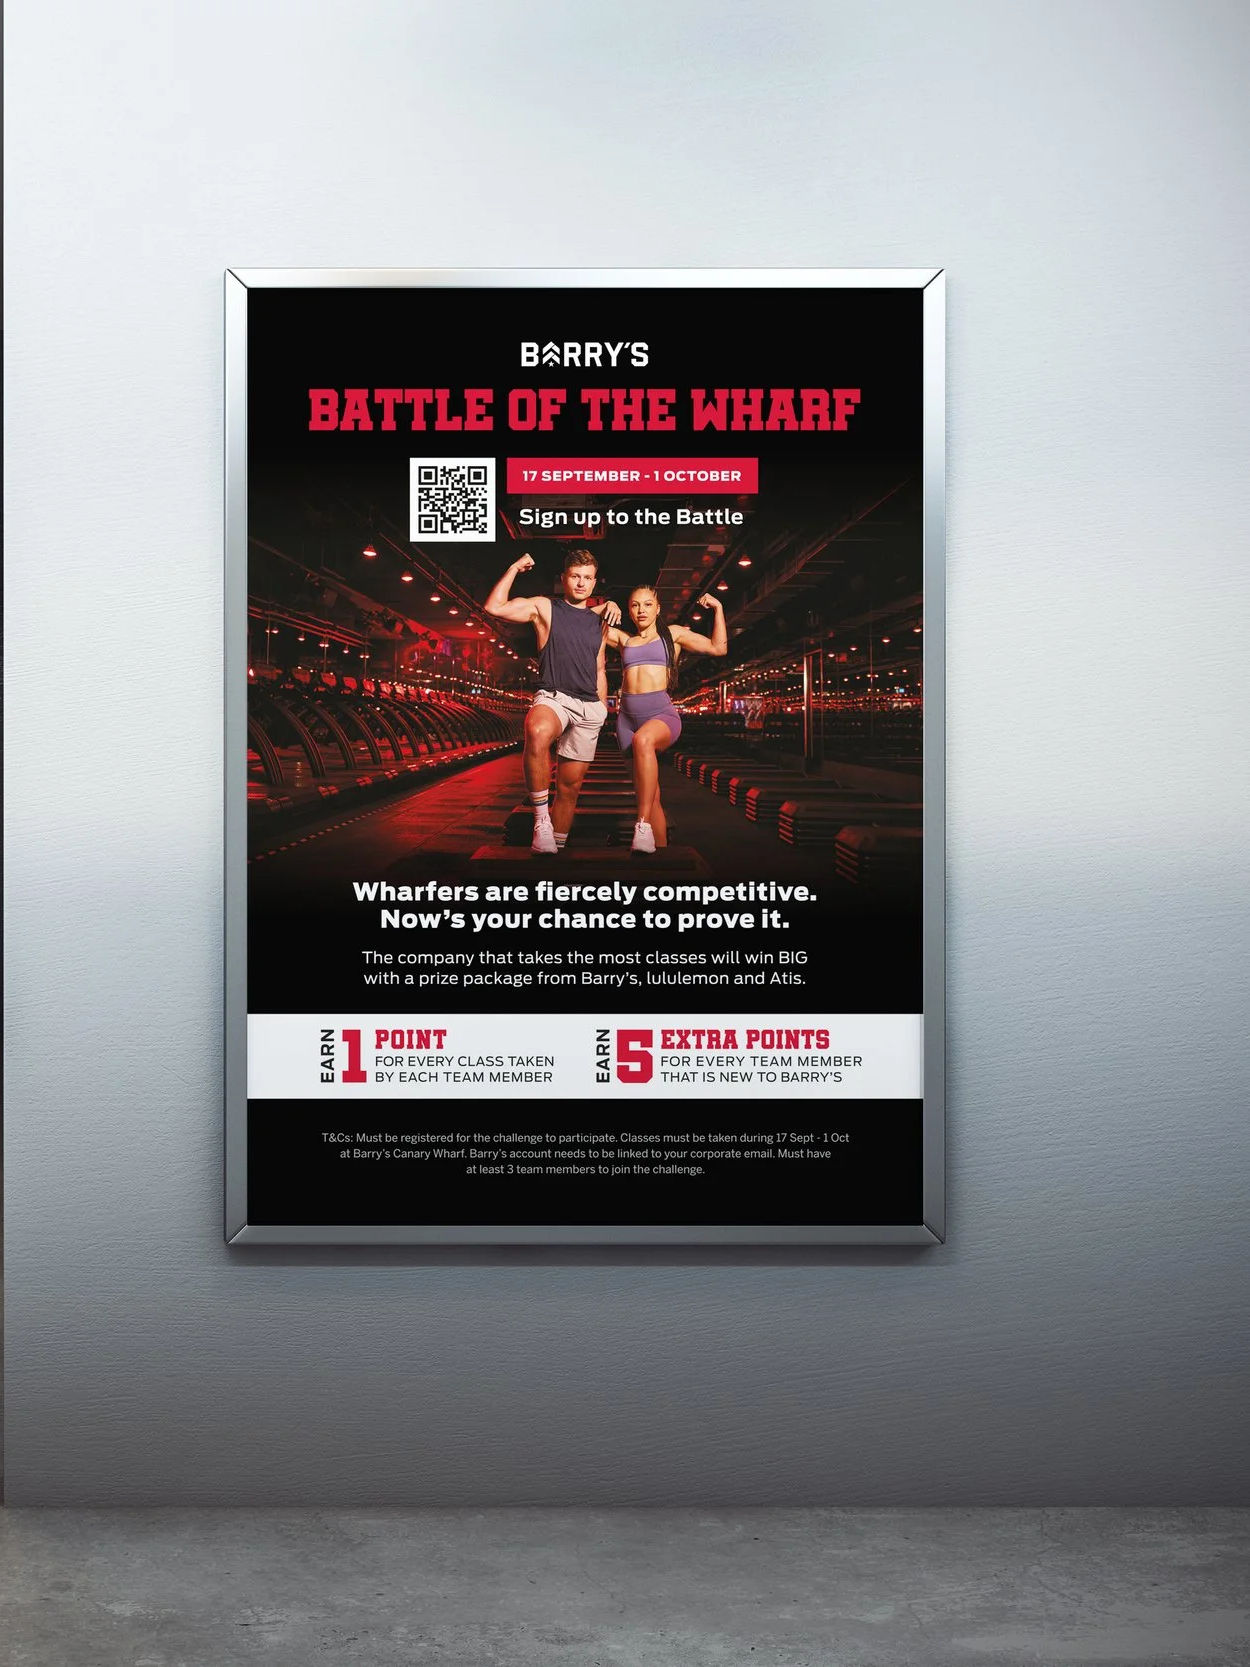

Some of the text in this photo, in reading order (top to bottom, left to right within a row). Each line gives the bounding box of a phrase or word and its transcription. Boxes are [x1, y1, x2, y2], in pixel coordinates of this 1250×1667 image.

[308, 388, 861, 431] BATTLE OF THE WHARF
[522, 470, 538, 482] 17
[541, 470, 641, 482] SEPTEMBER
[663, 470, 742, 482] OCTOBER
[519, 507, 744, 529] Sign up to the Battle
[352, 880, 817, 906] Wharfers are fiercely competitive.
[380, 908, 790, 933] Now's your chance to prove it.
[361, 950, 808, 967] The company that takes the most classes will win BIG
[363, 971, 806, 988] with a prize package from Barry's, lululemon and Atis.
[375, 1029, 447, 1050] POINT
[660, 1029, 830, 1050] EXTRA POINTS
[320, 1029, 335, 1083] EARN
[341, 1029, 367, 1084] 1
[375, 1055, 555, 1067] FOR EVERY CLASS TAKEN
[595, 1029, 611, 1084] EARN
[616, 1029, 654, 1084] 5
[660, 1055, 863, 1067] FOR EVERY TEAM MEMBER
[375, 1071, 553, 1083] BY EACH TEAM MEMBER
[660, 1071, 843, 1083] THAT IS NEW TO BARRY'S
[321, 1132, 354, 1143] T&Cs:
[356, 1132, 383, 1143] Must
[384, 1132, 399, 1143] be
[400, 1132, 454, 1145] registered
[455, 1132, 472, 1143] for
[472, 1132, 491, 1143] the
[492, 1132, 544, 1145] challenge
[544, 1132, 557, 1143] to
[558, 1132, 618, 1145] participate.
[620, 1132, 661, 1143] Classes
[663, 1132, 691, 1143] must
[692, 1132, 706, 1143] be
[707, 1132, 738, 1143] taken
[739, 1132, 774, 1145] during
[775, 1132, 788, 1143] 17
[789, 1132, 815, 1145] Sept
[830, 1132, 850, 1143] Oct
[339, 1148, 832, 1161] at Barry's Canary Wharf. Barry's account needs to be linked to your corporate email. Must have
[465, 1164, 706, 1177] at least 3 team members to join the challenge.
